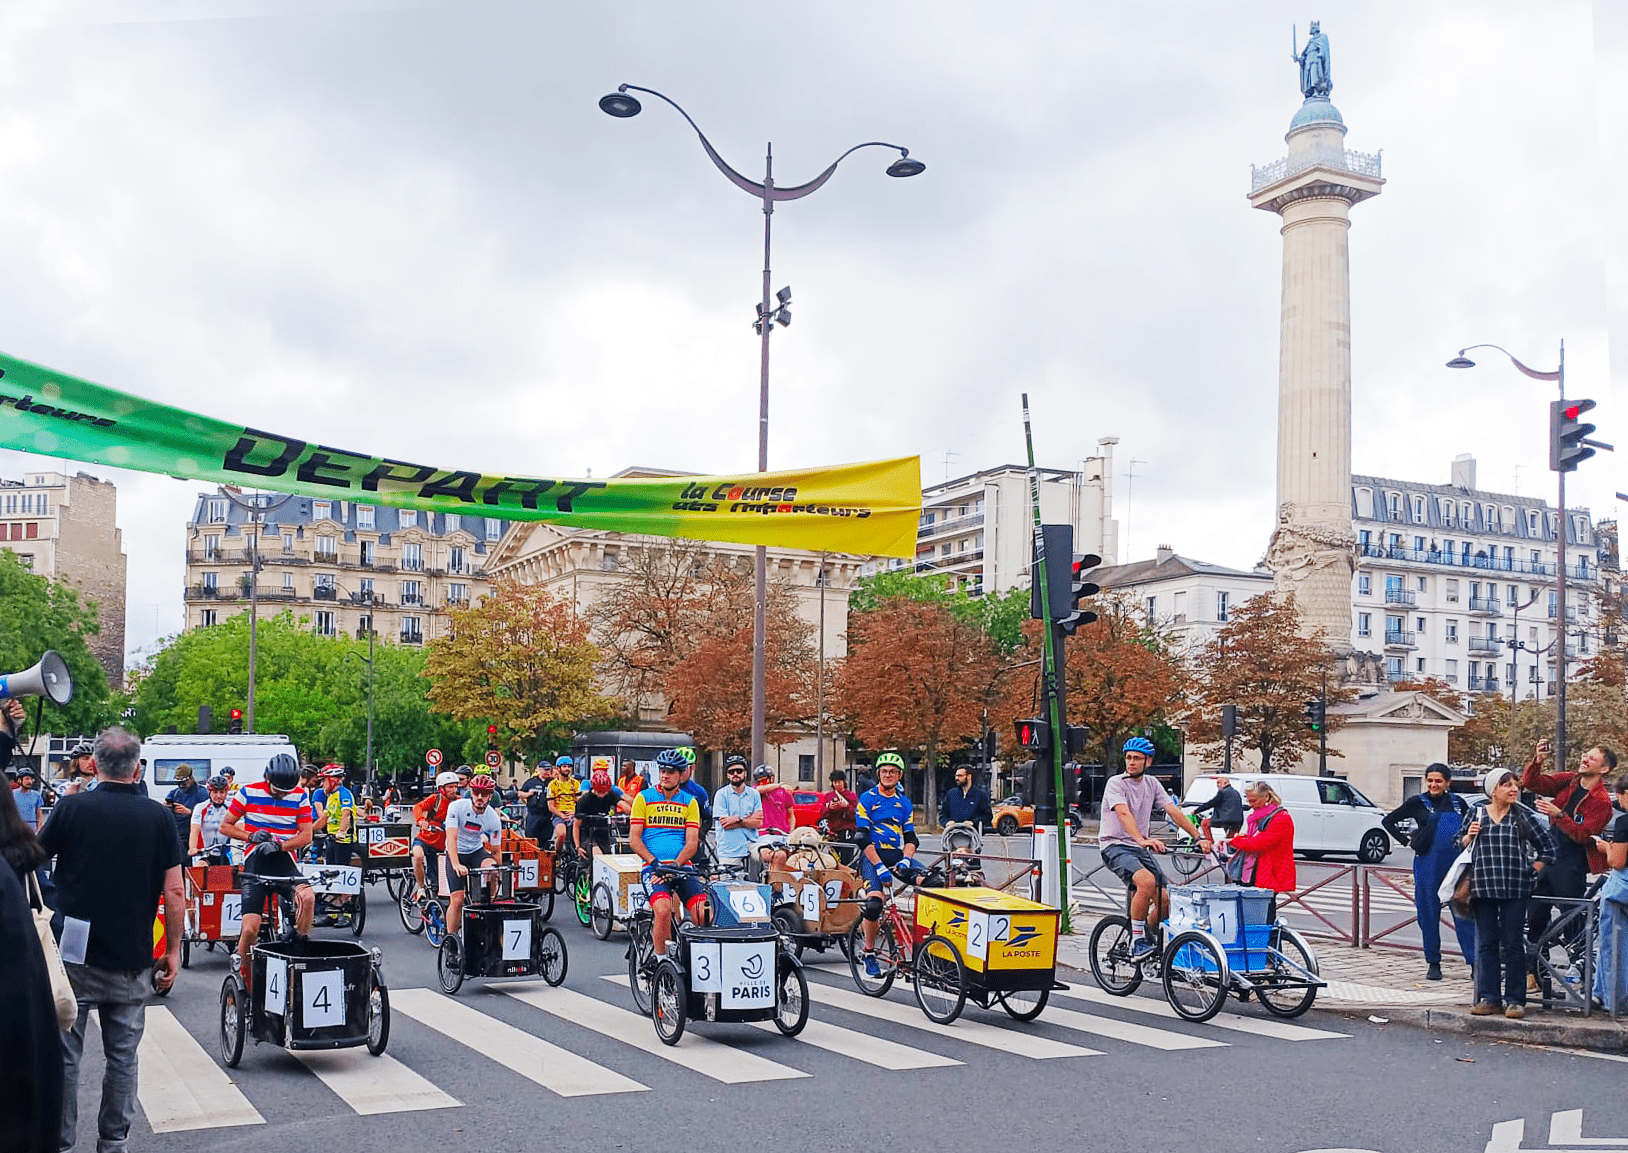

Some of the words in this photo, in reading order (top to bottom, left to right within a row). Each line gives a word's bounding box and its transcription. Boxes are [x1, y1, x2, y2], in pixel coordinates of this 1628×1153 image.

[681, 482, 707, 499] la
[712, 483, 797, 501] Course
[489, 755, 499, 763] 30
[656, 805, 682, 813] CYCLES
[370, 829, 383, 842] 18
[341, 870, 357, 886] 16
[520, 866, 535, 881] 15
[825, 887, 836, 900] 9
[226, 903, 243, 921] 12
[743, 896, 755, 912] 6
[808, 894, 815, 912] 5
[994, 917, 1009, 941] 2
[1218, 912, 1226, 934] 1
[510, 930, 522, 950] 7
[971, 922, 982, 948] 2
[697, 955, 711, 981] 3
[270, 972, 280, 1000] 4
[732, 985, 771, 999] PARIS
[312, 985, 332, 1013] 4
